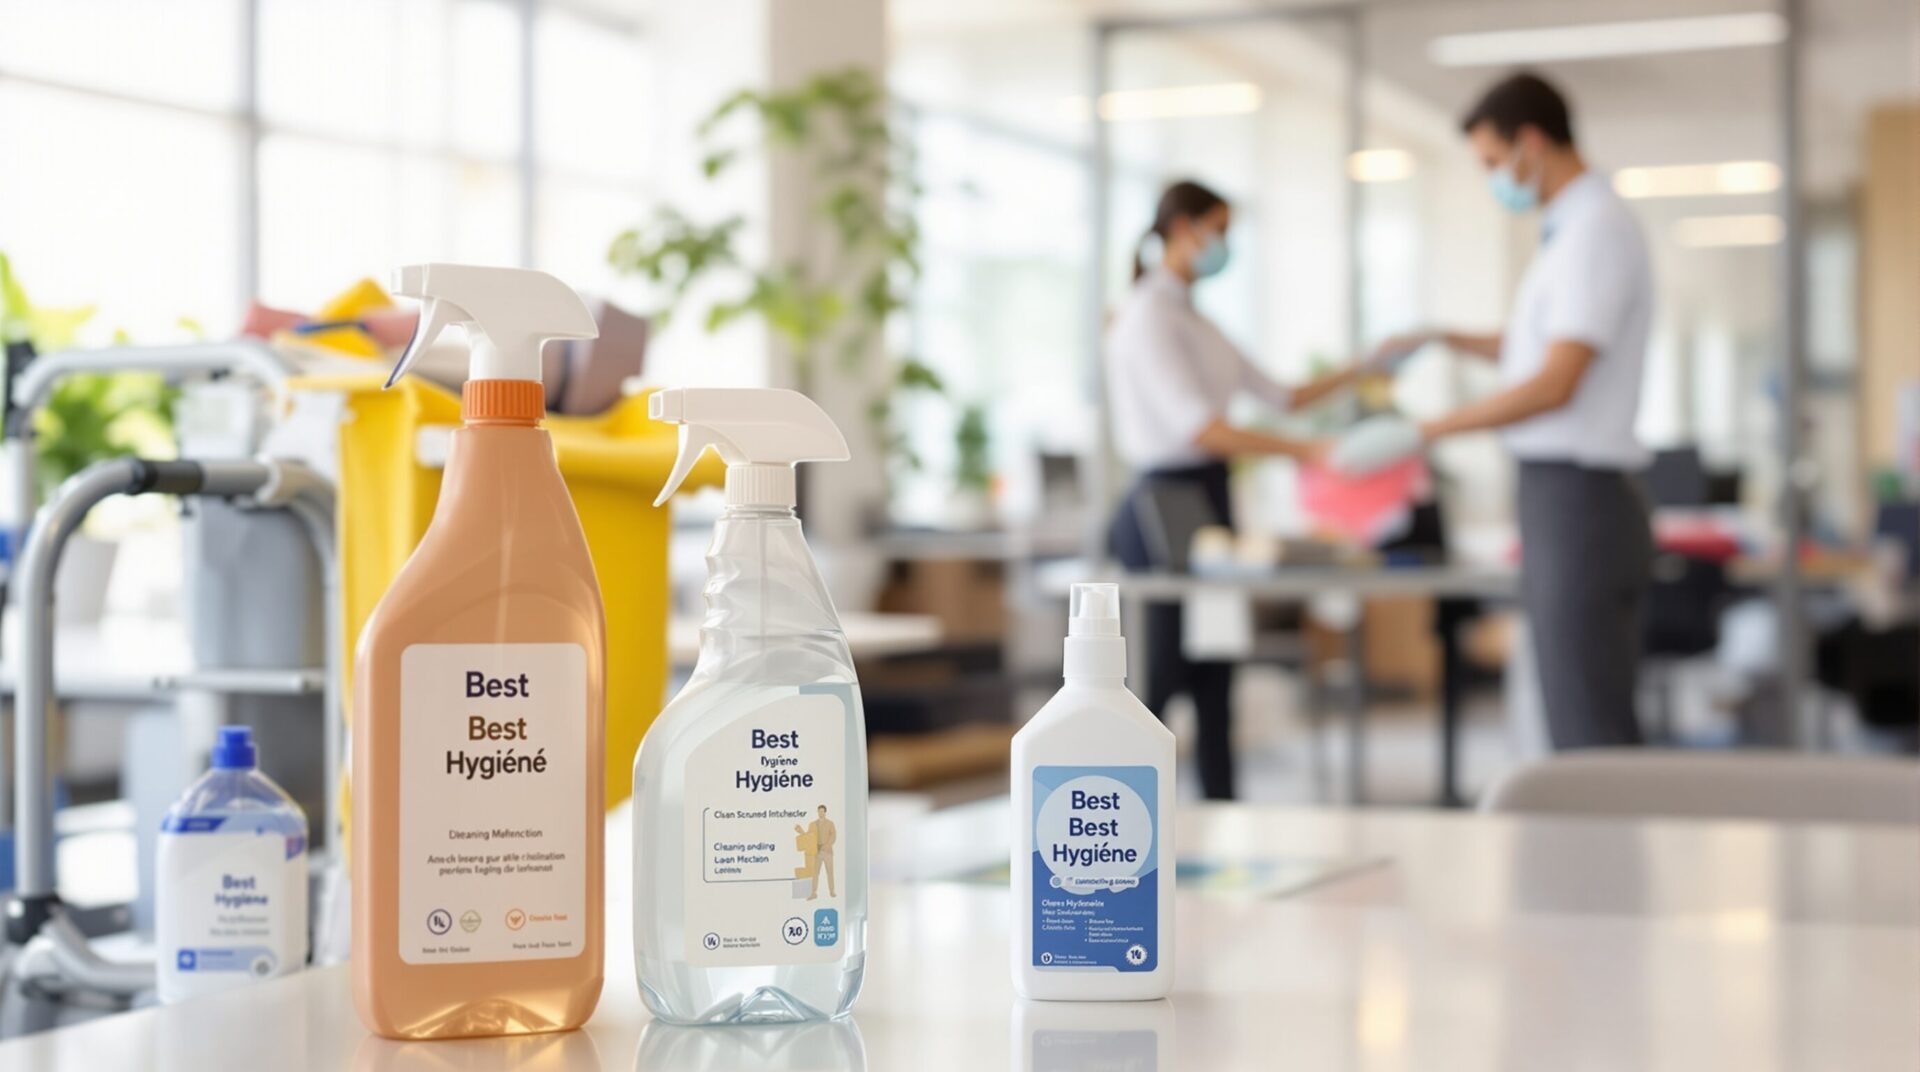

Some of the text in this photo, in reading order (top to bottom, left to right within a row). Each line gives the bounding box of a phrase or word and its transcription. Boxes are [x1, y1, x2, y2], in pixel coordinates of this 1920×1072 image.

[466, 670, 529, 698] Best
[468, 715, 527, 741] Best
[752, 729, 799, 749] Best
[735, 769, 814, 792] Hygiéne
[1071, 790, 1120, 810] Best
[1069, 817, 1119, 837] Best
[1052, 841, 1138, 867] Hygiéne
[222, 874, 256, 890] Best
